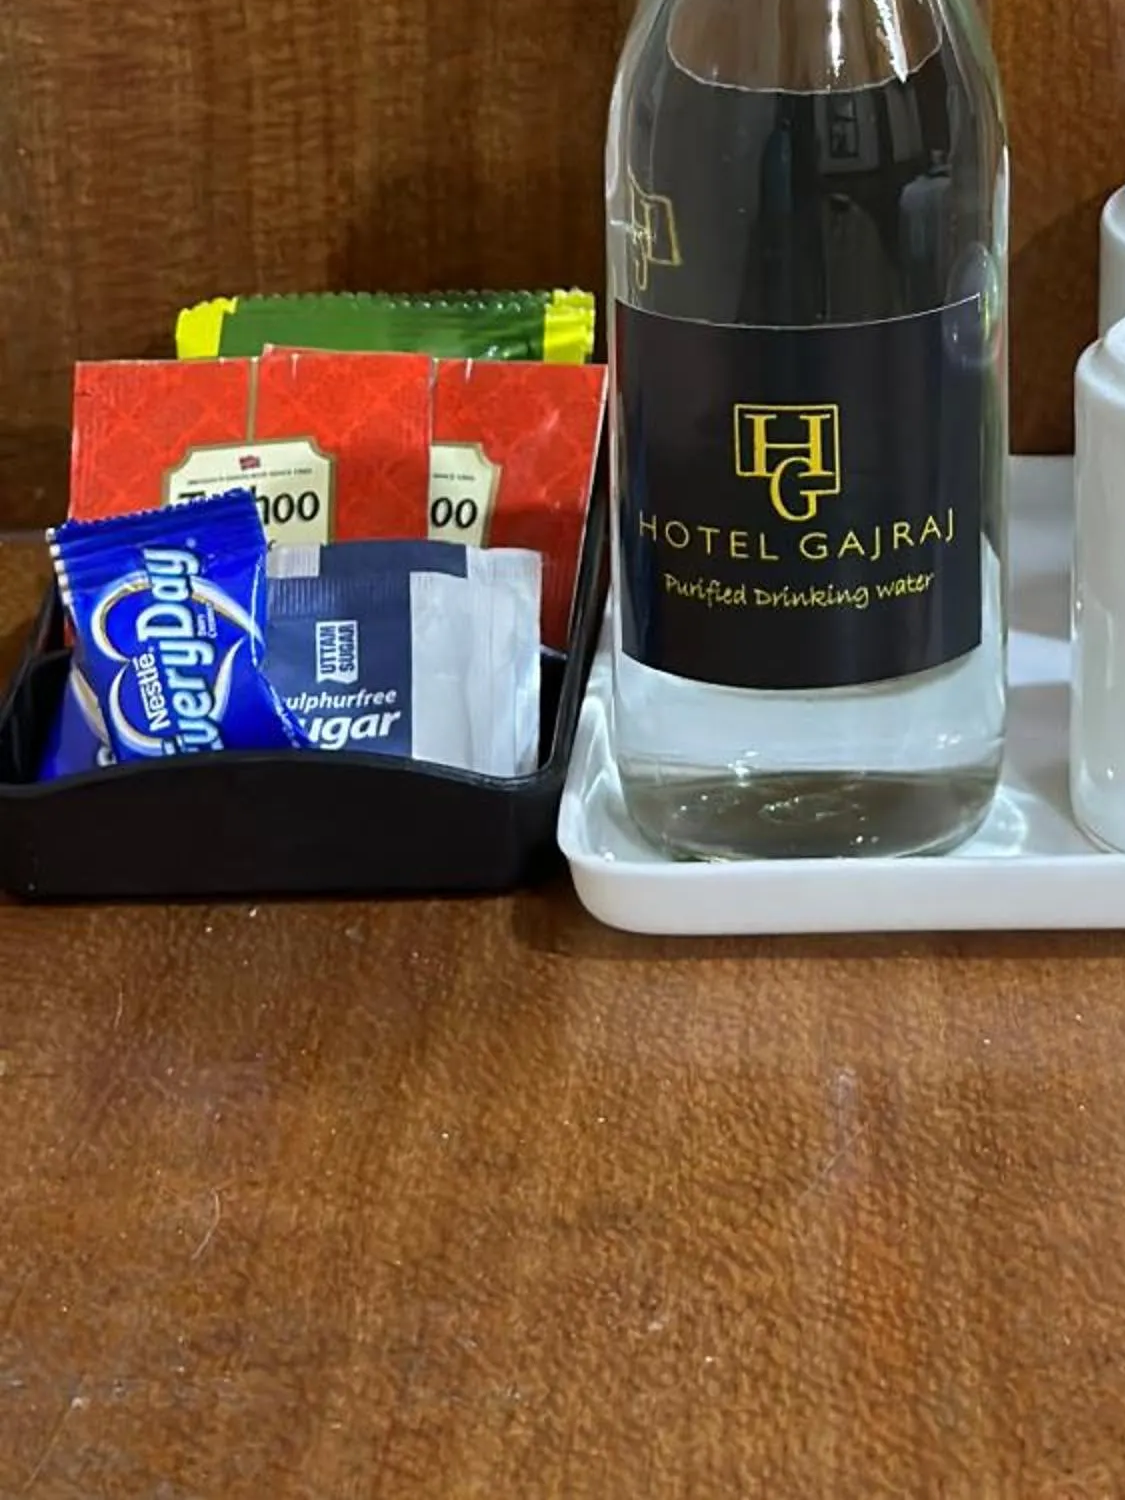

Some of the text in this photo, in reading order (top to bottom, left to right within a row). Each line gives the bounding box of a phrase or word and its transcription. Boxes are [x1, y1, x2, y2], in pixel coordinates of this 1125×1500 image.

[639, 507, 954, 562] HOTEL GAJRAJ
[663, 572, 936, 609] Purified Drinking water
[283, 688, 397, 713] ulphurfree
[298, 711, 401, 750] ugar
